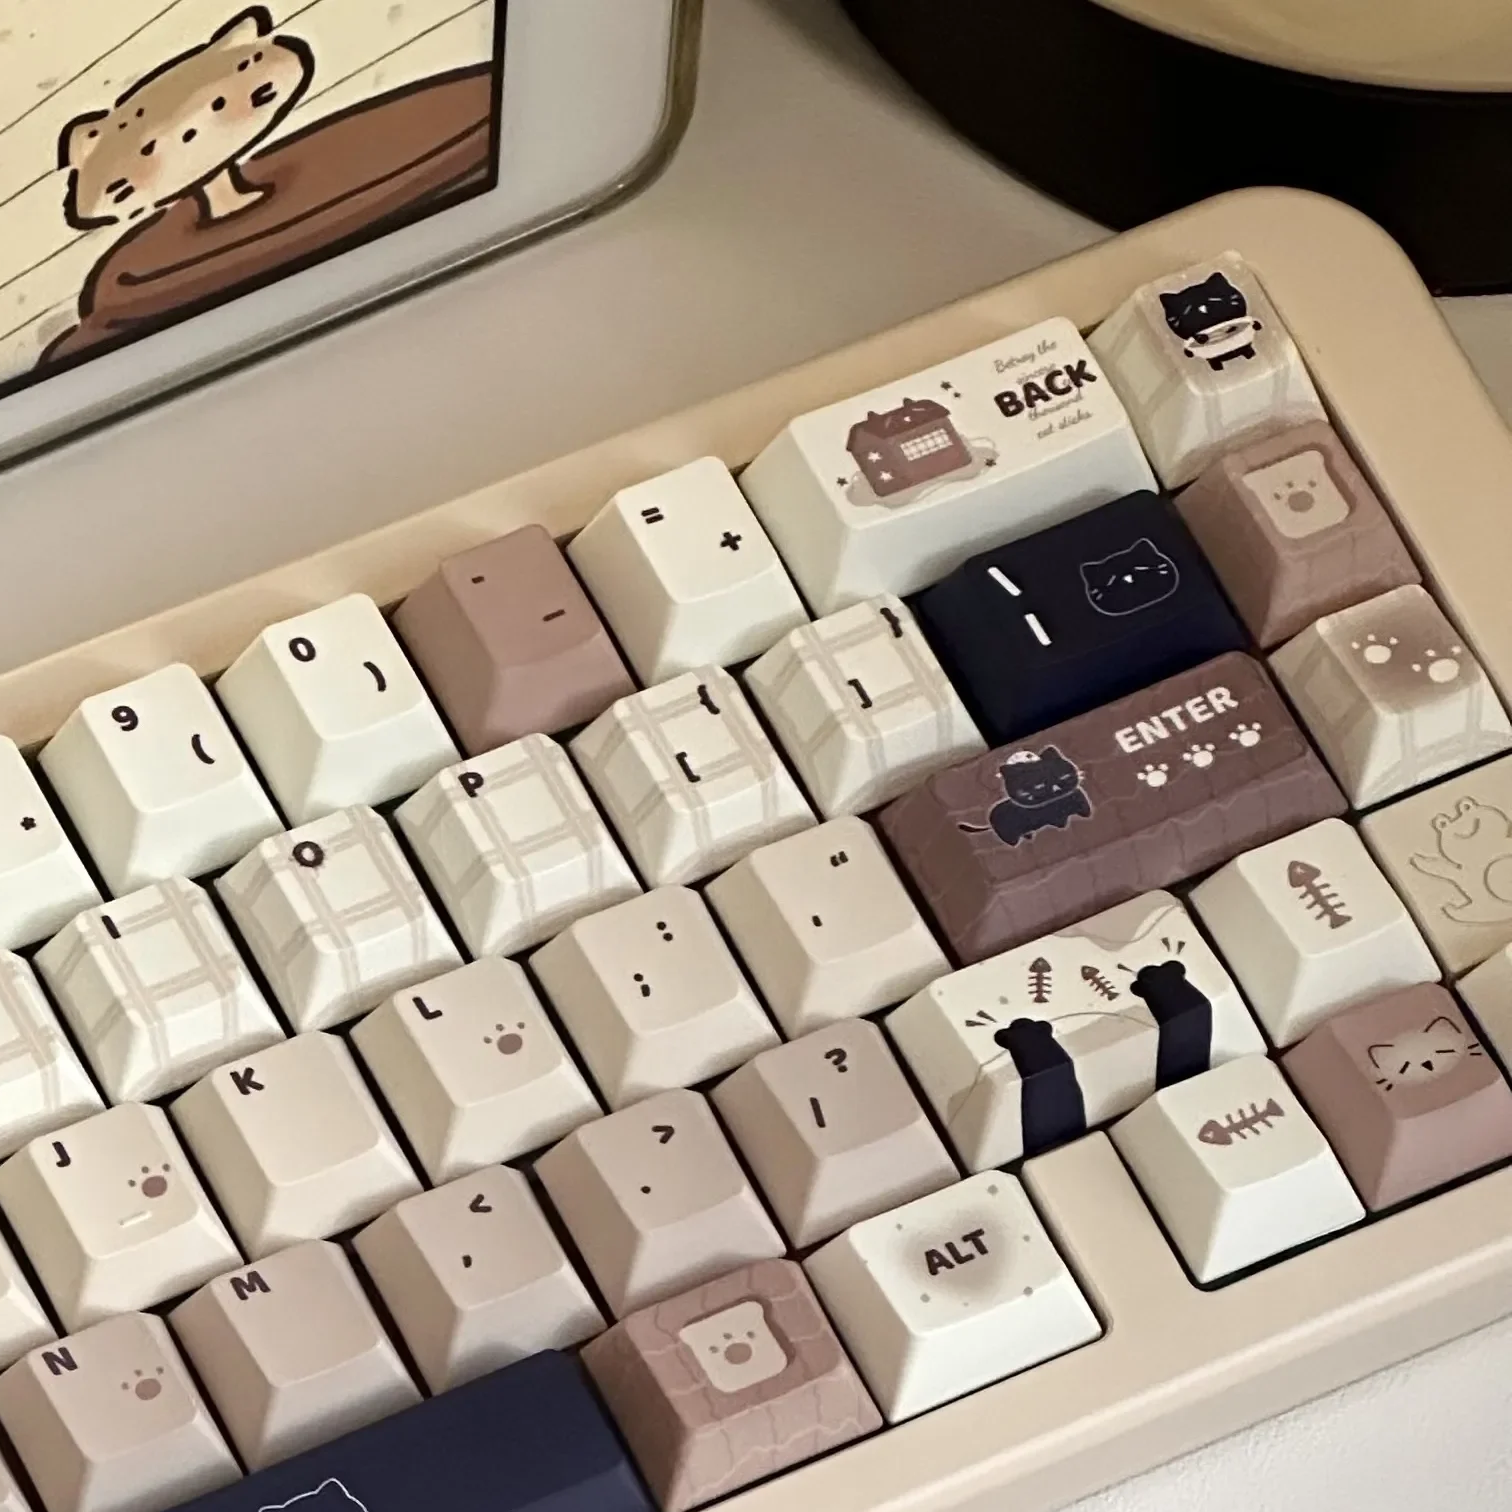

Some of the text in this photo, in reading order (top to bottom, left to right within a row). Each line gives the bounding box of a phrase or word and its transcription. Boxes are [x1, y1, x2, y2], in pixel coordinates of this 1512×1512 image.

[993, 359, 1097, 418] BACK
[288, 637, 316, 663] 0
[111, 705, 139, 732] 9
[1114, 686, 1239, 754] ENTER
[457, 771, 484, 798] P
[292, 840, 325, 869] O
[100, 915, 122, 940] I
[412, 996, 443, 1021] L
[229, 1067, 265, 1096] K
[51, 1141, 71, 1168] J
[924, 1228, 989, 1276] ALT
[229, 1270, 271, 1301] M
[41, 1347, 78, 1376] N
